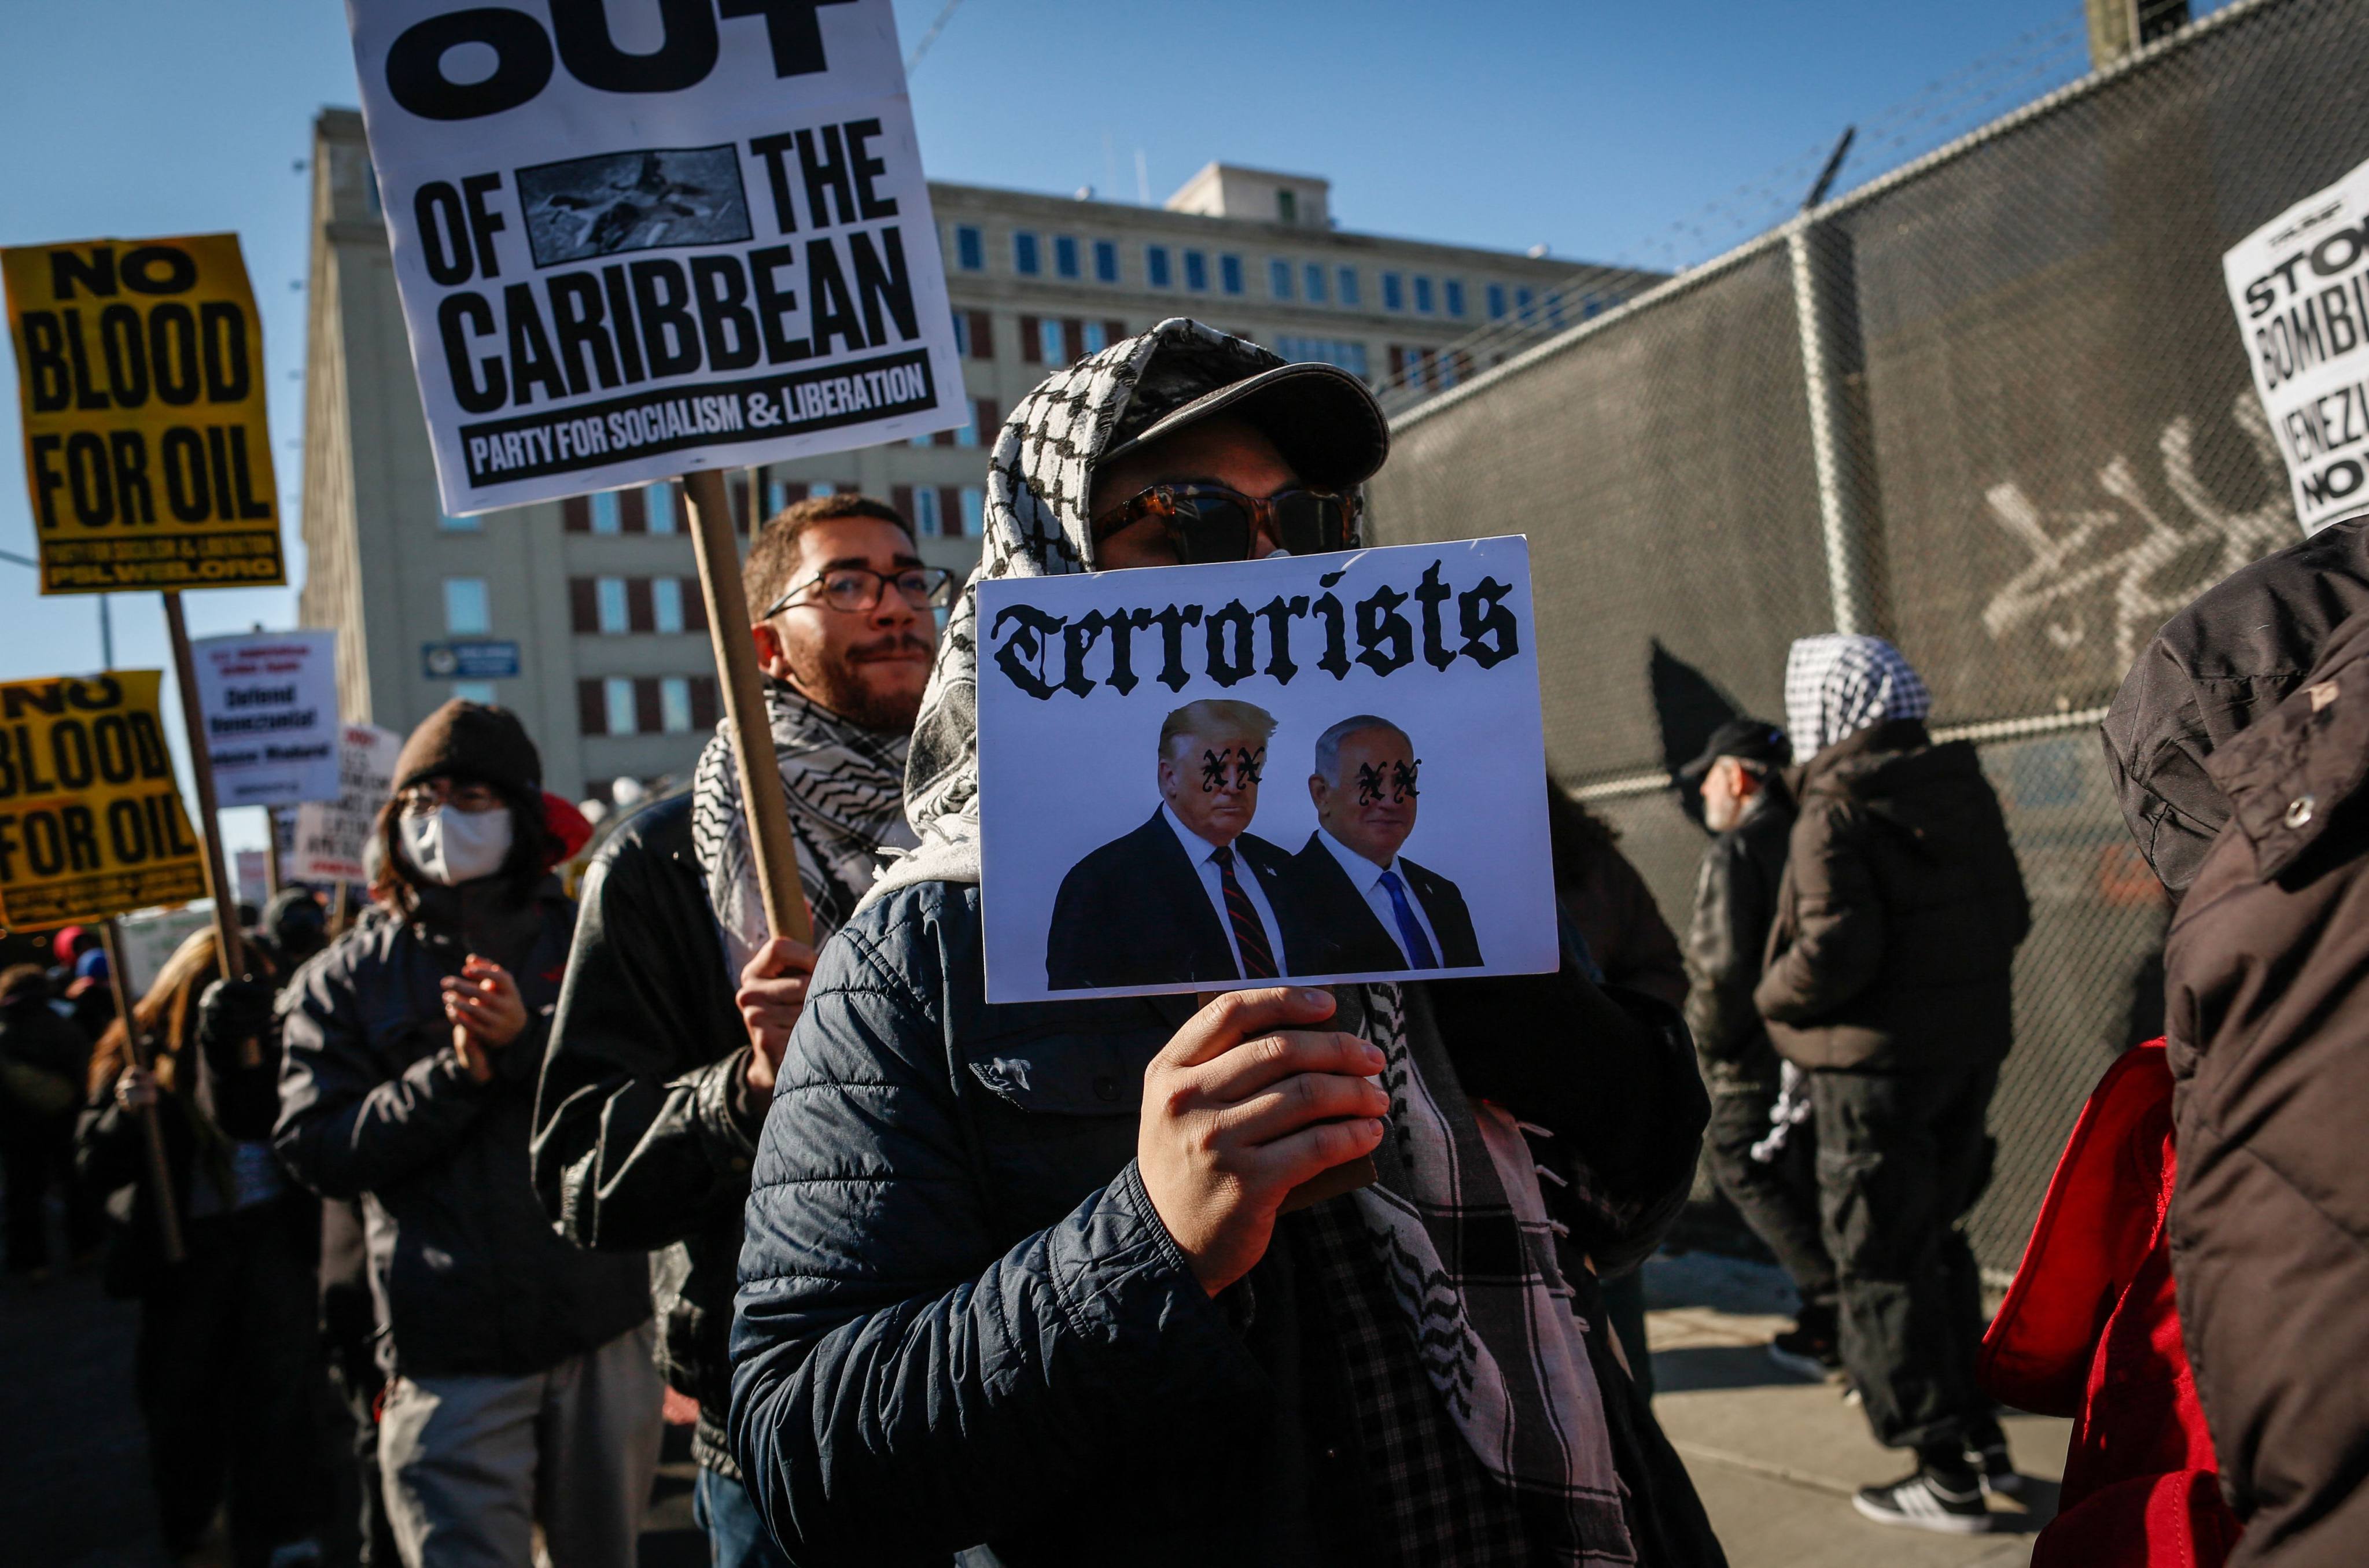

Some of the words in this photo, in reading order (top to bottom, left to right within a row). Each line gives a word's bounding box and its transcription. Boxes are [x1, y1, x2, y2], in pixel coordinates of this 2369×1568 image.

[386, 0, 858, 120] OUT
[414, 172, 504, 286] OF
[749, 118, 899, 235] THE
[50, 245, 198, 300] NO
[2246, 213, 2369, 319] STO
[21, 301, 250, 412] BLOOD
[438, 227, 920, 414] CARIBBEAN
[2256, 268, 2369, 389] BOMBI
[469, 424, 553, 475] PARTY
[556, 415, 609, 460] FOR
[610, 393, 743, 448] SOCIALISM
[747, 392, 782, 427] &
[784, 361, 926, 424] LIBERATION
[2282, 379, 2369, 464] ENEZ
[32, 430, 157, 529] FOR
[161, 425, 271, 523] OIL
[2301, 451, 2369, 512] NO
[990, 559, 1520, 700] Terrorists
[2, 673, 123, 719] NO
[0, 805, 102, 883] FOR
[108, 793, 197, 865] OIL
